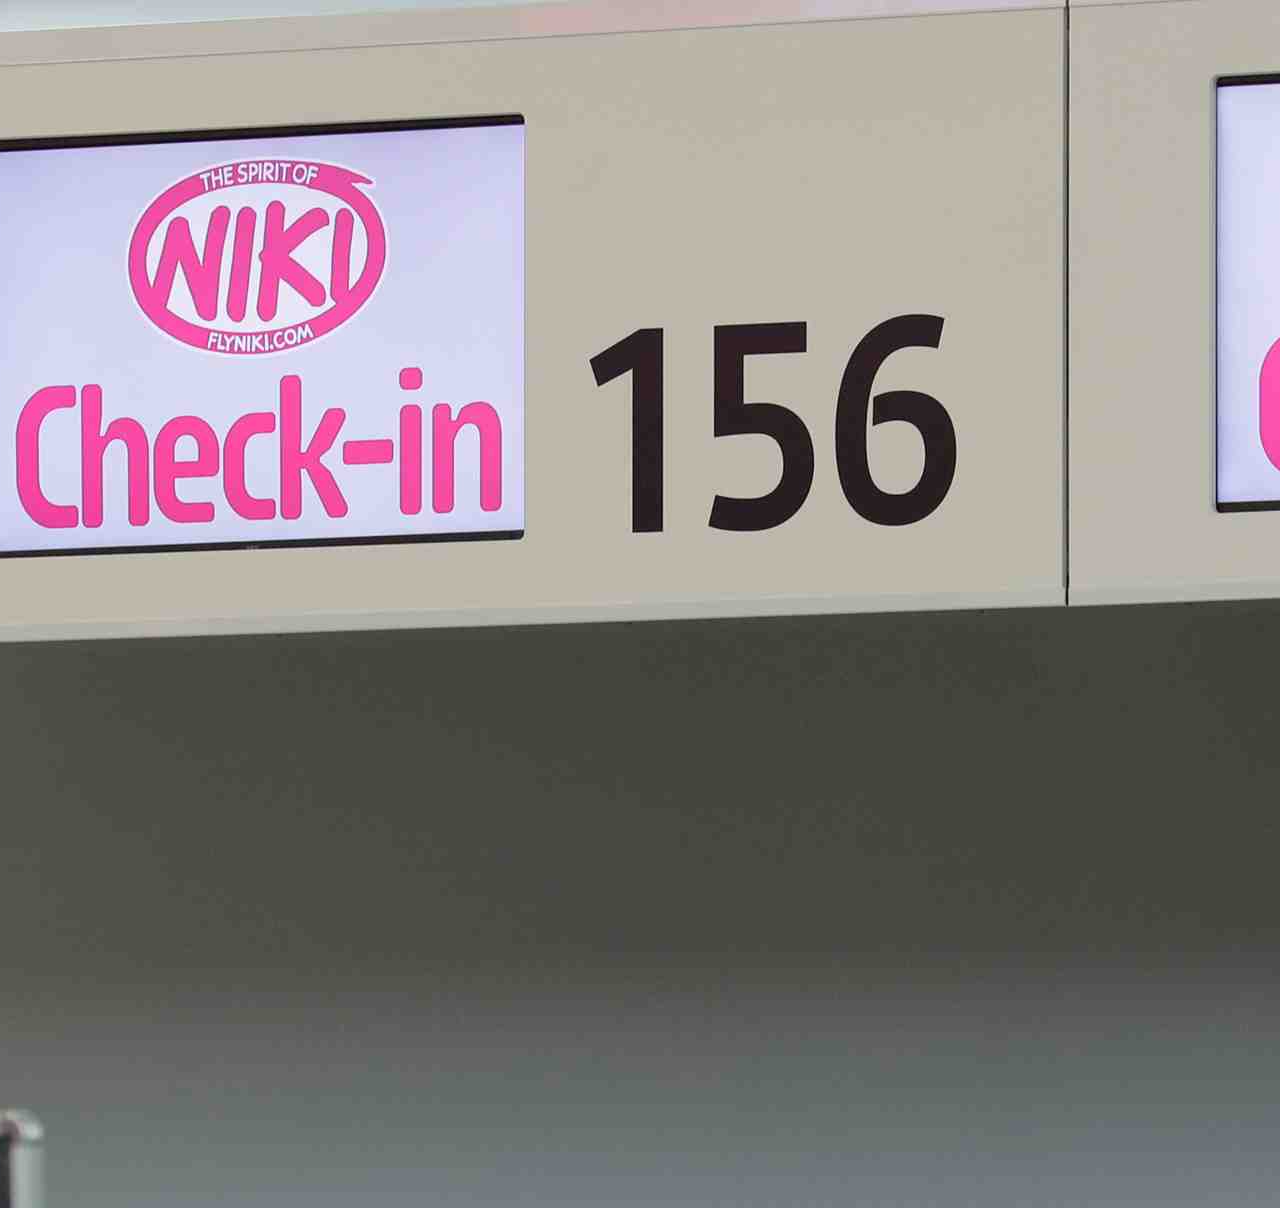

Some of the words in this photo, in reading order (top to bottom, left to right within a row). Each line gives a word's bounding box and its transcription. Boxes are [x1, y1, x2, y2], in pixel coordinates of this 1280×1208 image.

[200, 166, 234, 192] THE
[237, 162, 291, 184] SPIRIT
[291, 163, 319, 186] OF
[150, 200, 354, 323] NIKI
[207, 324, 314, 353] FLYNIKI.COM
[15, 366, 503, 529] Check-in
[588, 313, 958, 533] 156
